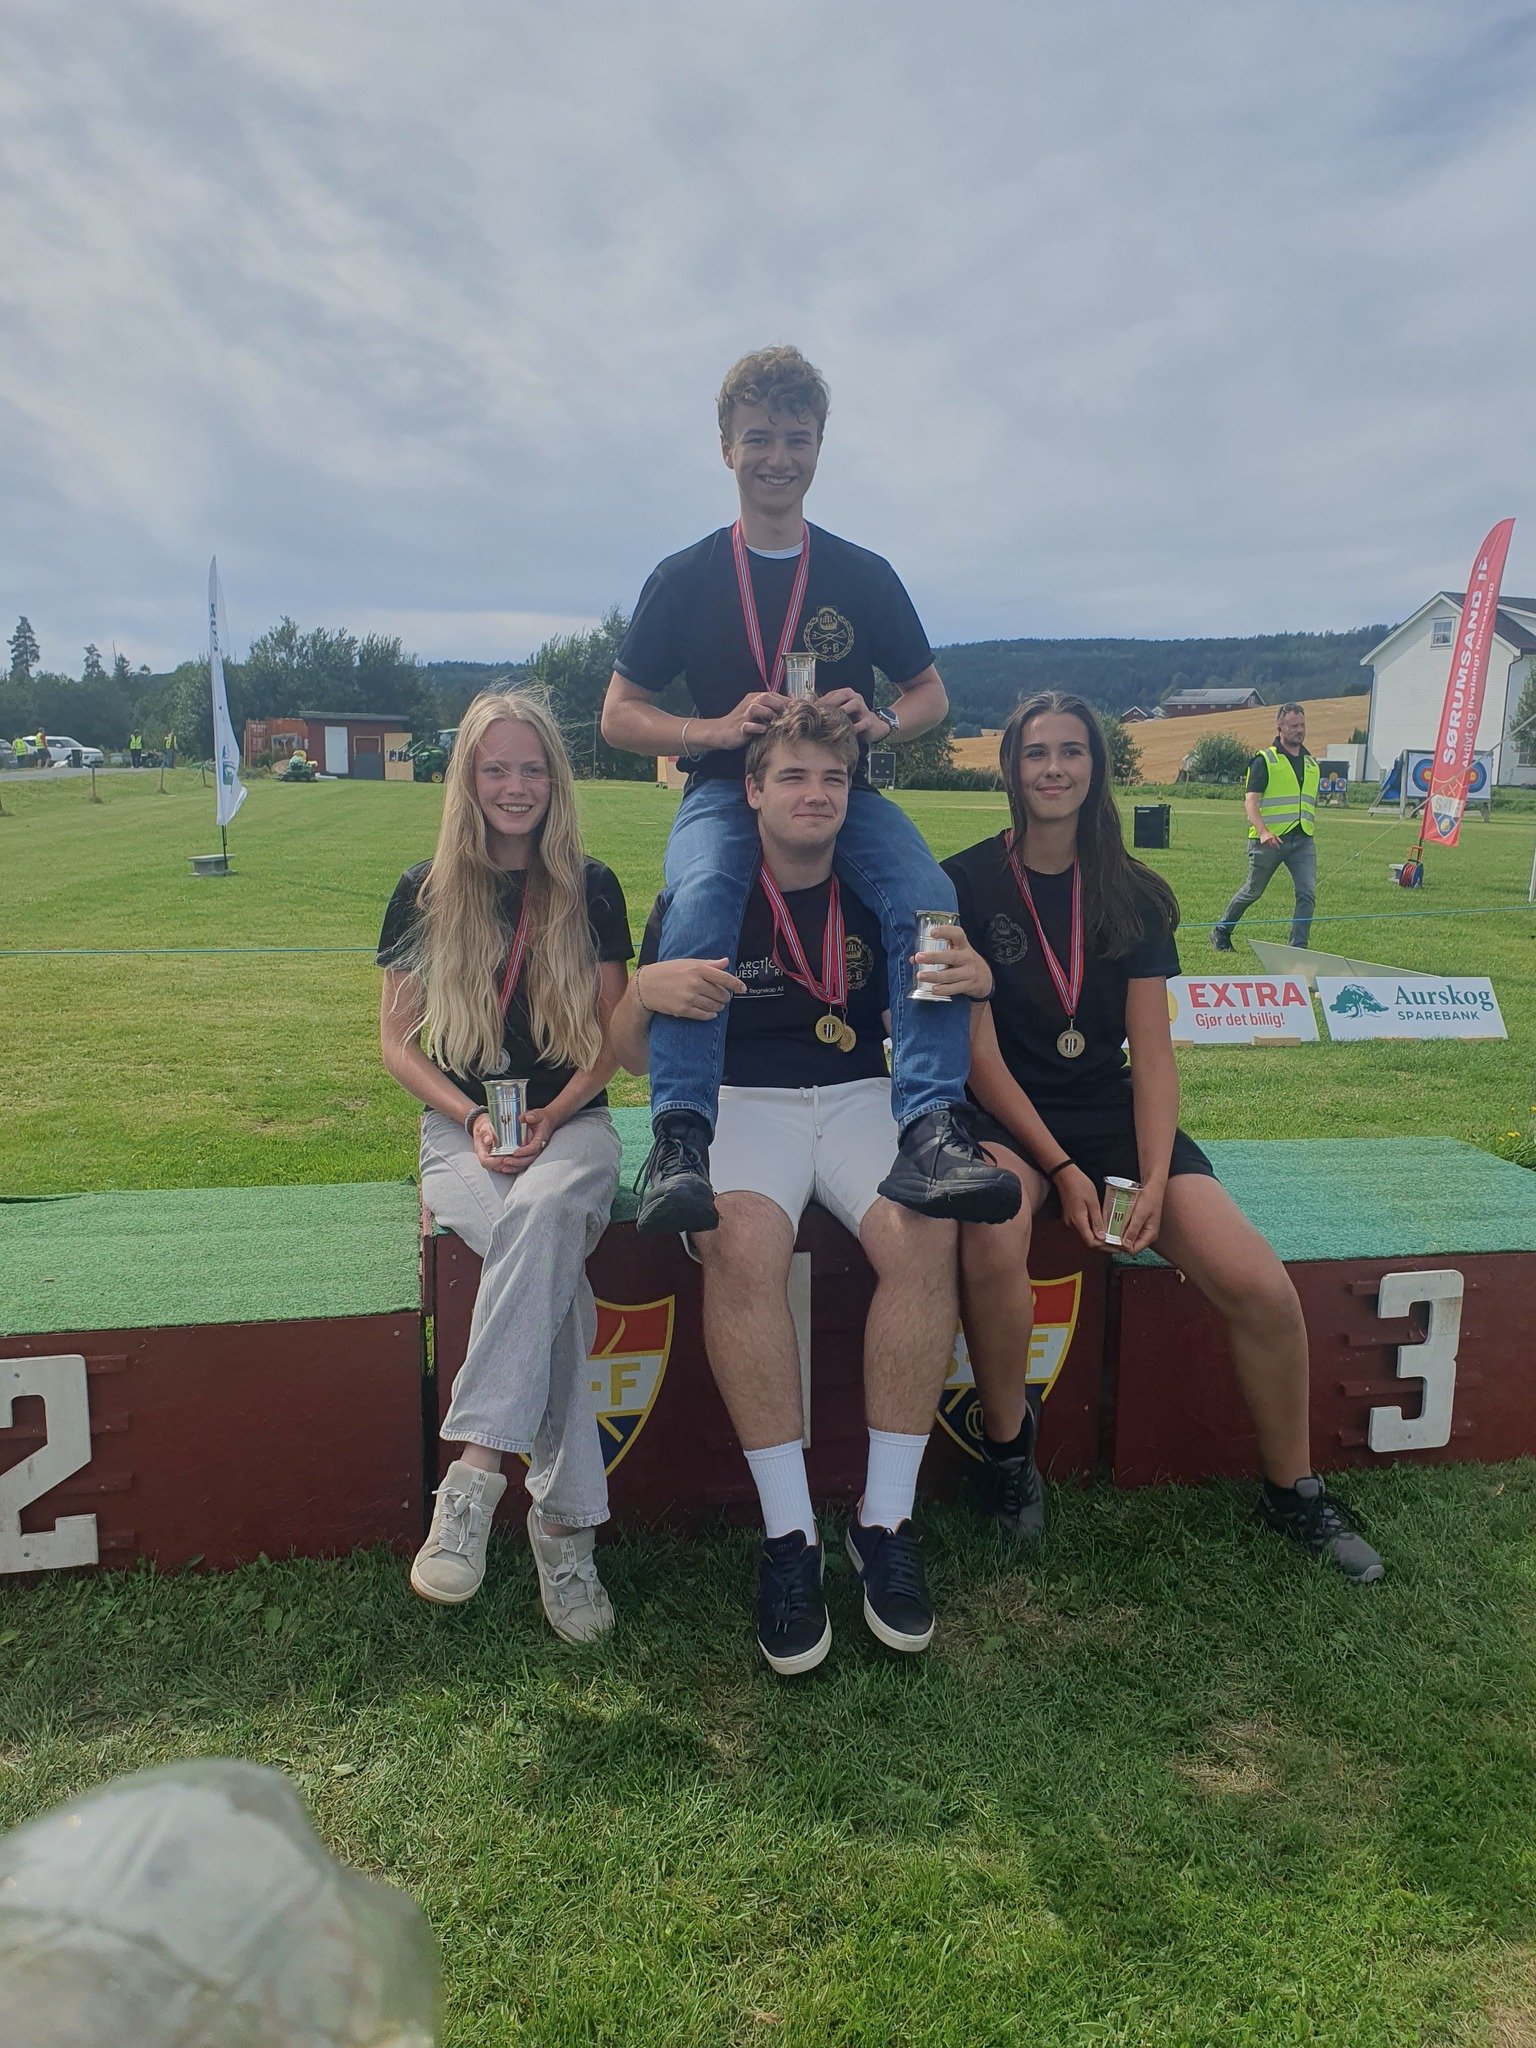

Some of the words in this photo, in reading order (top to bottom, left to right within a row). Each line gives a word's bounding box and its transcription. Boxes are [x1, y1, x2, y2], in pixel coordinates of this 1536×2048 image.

[1442, 591, 1483, 766] SØRUMSAND
[1466, 710, 1477, 729] og
[1461, 730, 1474, 769] Aktivt
[737, 957, 776, 974] ARCTIC
[1188, 981, 1307, 1009] EXTRA
[1394, 984, 1495, 1012] Aurskog
[1195, 1013, 1222, 1030] Gjør
[1226, 1012, 1247, 1027] det
[1249, 1012, 1285, 1029] billig!
[1397, 1010, 1480, 1021] SPAREBANK
[1368, 1269, 1465, 1453] 3
[0, 1354, 99, 1575] 2
